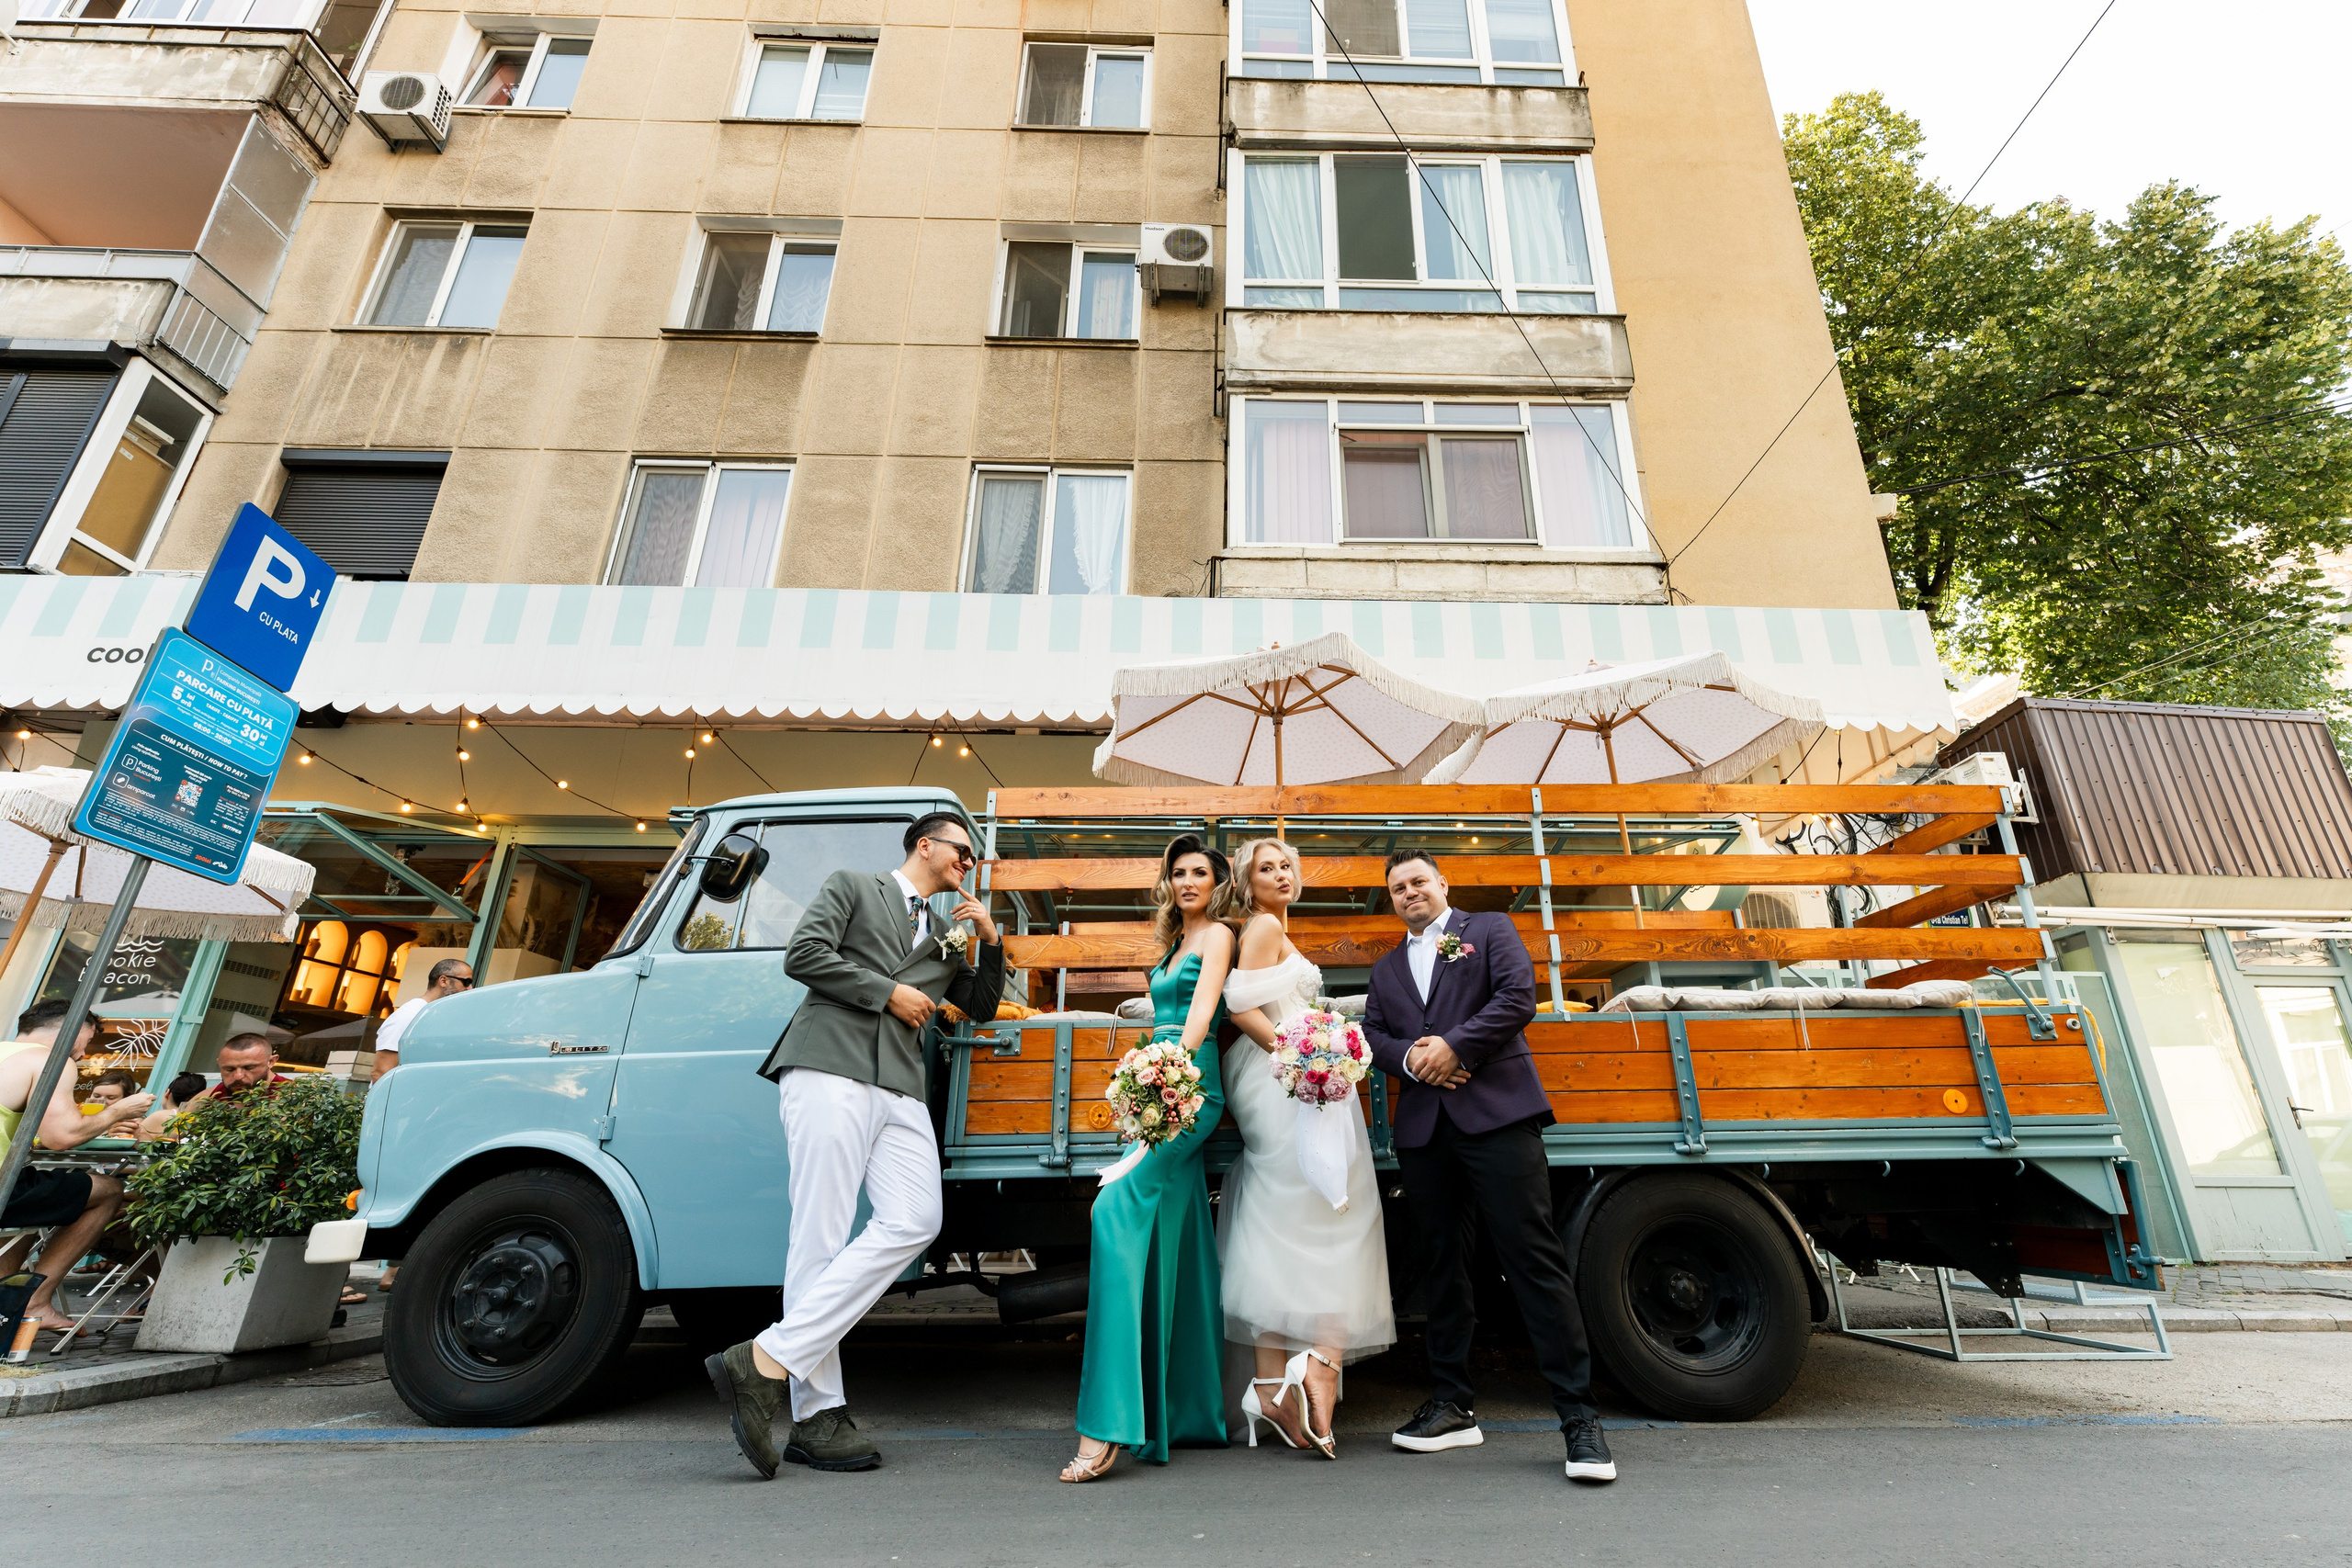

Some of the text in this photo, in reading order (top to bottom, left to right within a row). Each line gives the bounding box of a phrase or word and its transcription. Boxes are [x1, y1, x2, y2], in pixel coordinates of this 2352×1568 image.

[234, 535, 306, 613] P
[259, 612, 299, 644] CU PLATA
[216, 676, 236, 691] PARKING
[171, 685, 184, 700] 5
[176, 670, 273, 730] PARCARE CU PLATĂ
[187, 693, 196, 701] lei
[180, 699, 192, 708] oră
[206, 703, 220, 714] TARIFE
[193, 722, 211, 734] 08:00
[215, 733, 232, 745] 20:00
[240, 724, 260, 741] 30
[260, 733, 268, 741] lei
[160, 733, 176, 745] CUM
[175, 741, 205, 759] PLĂTEȘTI
[208, 757, 224, 769] HOW
[223, 764, 232, 773] TO
[232, 768, 244, 778] PAY
[135, 766, 162, 782] București
[138, 761, 160, 774] Parking
[127, 784, 156, 799] amparcat
[85, 952, 156, 968] okie
[77, 967, 152, 985] acon
